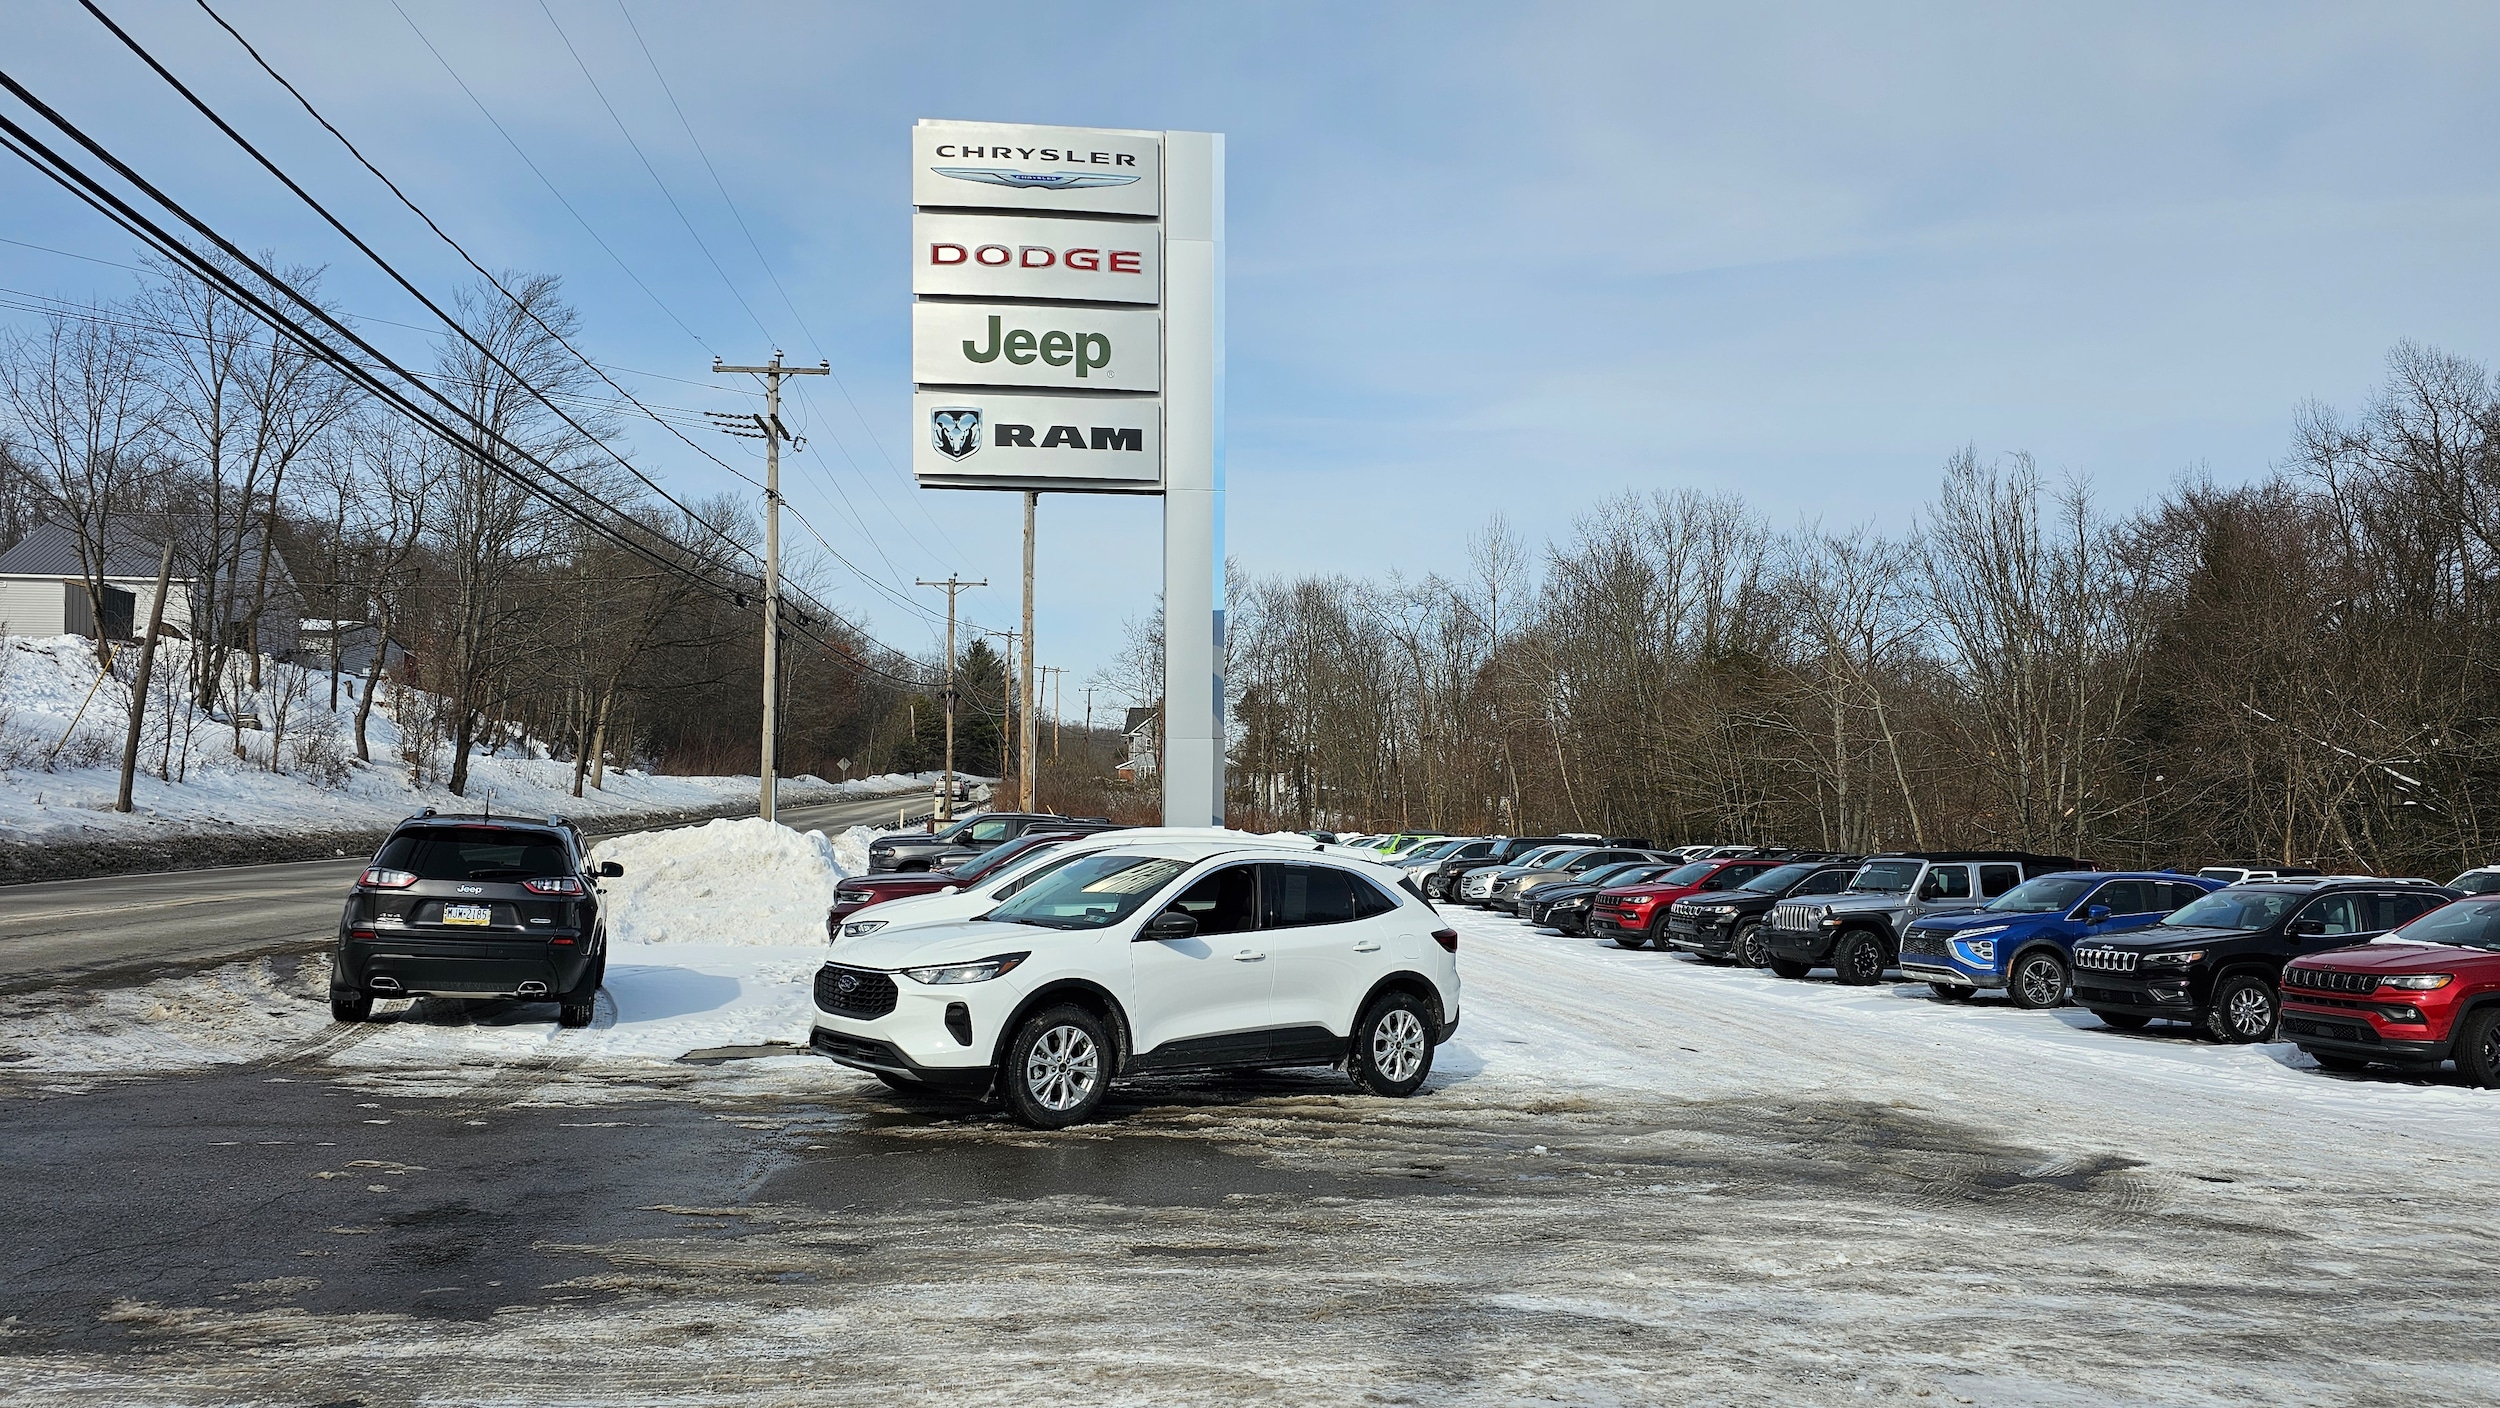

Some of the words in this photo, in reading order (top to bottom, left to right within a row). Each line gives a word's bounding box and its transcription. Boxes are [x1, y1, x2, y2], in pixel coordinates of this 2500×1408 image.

[935, 145, 1136, 167] CHRYSLER
[930, 243, 1142, 275] DODGE
[962, 315, 1112, 378] Jeep
[994, 423, 1143, 452] RAM
[456, 884, 483, 895] Jeep
